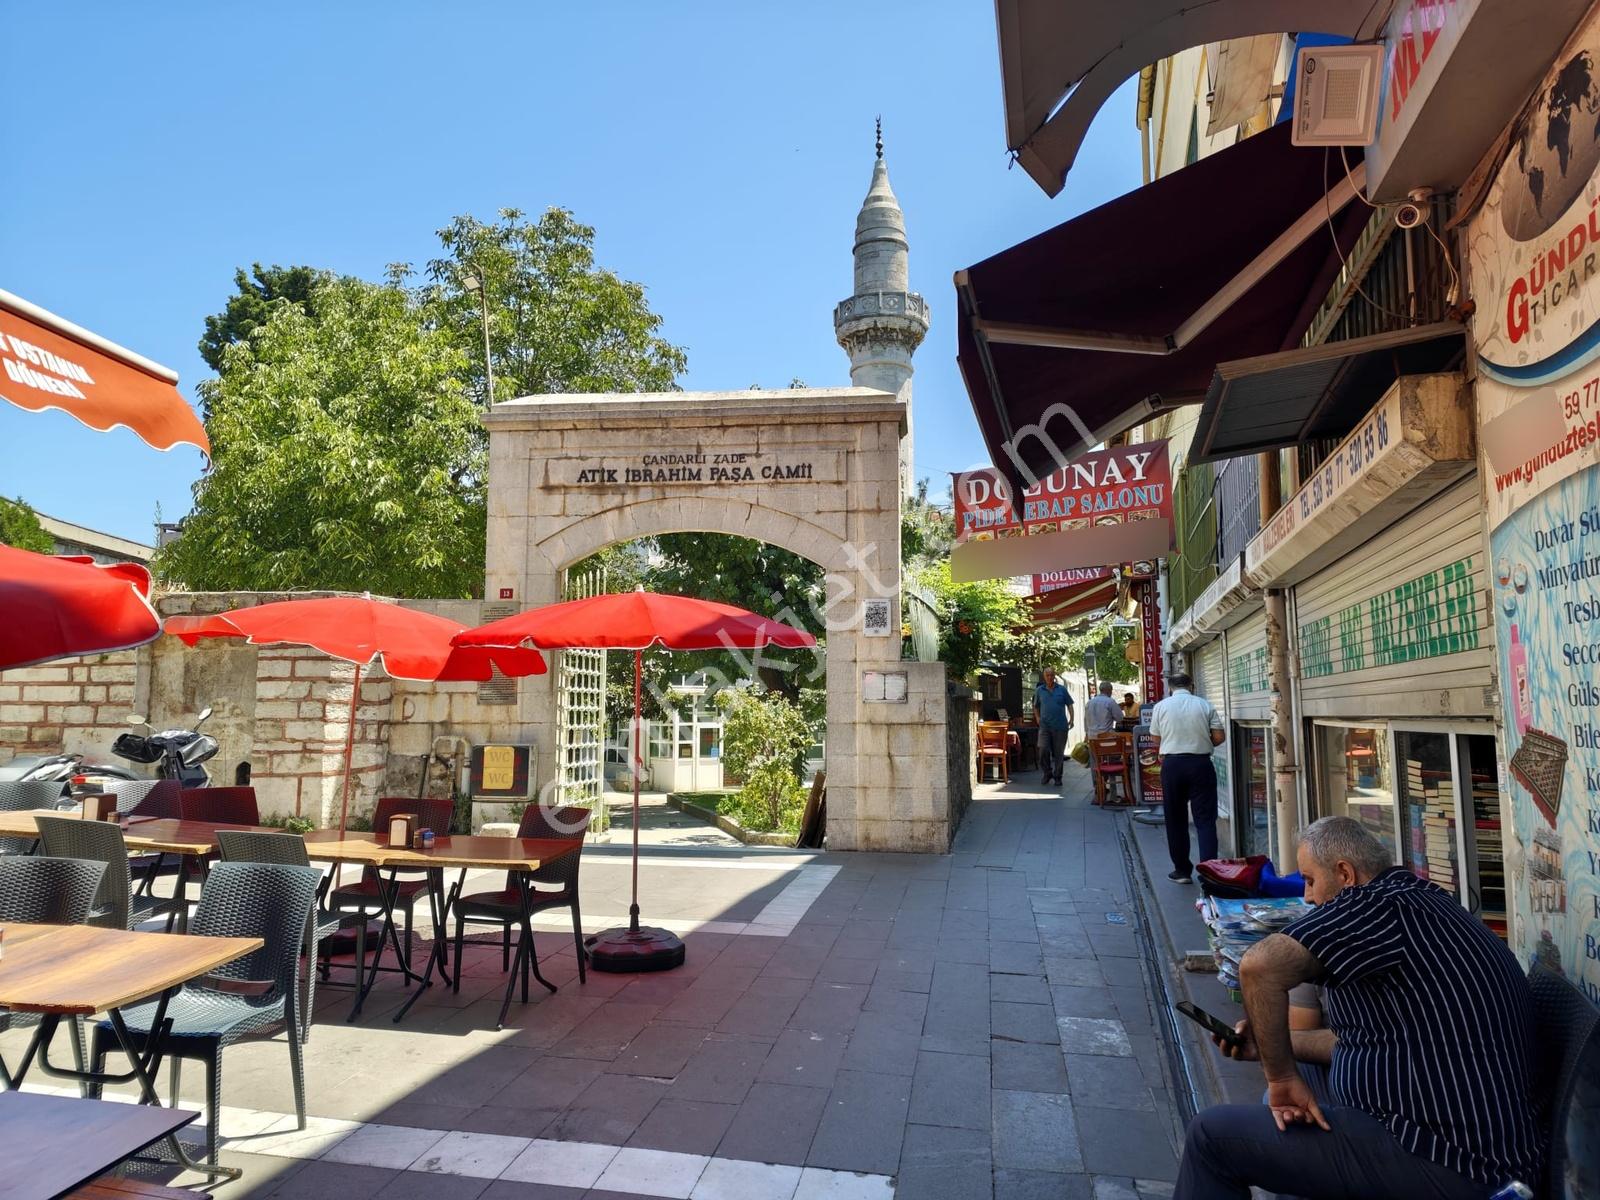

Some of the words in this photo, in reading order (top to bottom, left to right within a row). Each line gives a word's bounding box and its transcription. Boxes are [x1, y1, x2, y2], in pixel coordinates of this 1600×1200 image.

[1565, 391, 1580, 419] 59
[1583, 378, 1600, 408] 77
[1365, 423, 1375, 463] 55
[1377, 408, 1388, 451] 86
[713, 454, 748, 465] ZADE
[577, 467, 618, 483] ATİK
[625, 465, 702, 483] İBRAHİM
[709, 466, 755, 483] PAŞA
[761, 463, 813, 480] CAMİİ
[1080, 483, 1164, 514] SALONU
[1535, 521, 1575, 553] Duvar
[1041, 567, 1101, 583] DOLUNAY
[1143, 583, 1153, 664] DOLUNAY
[489, 751, 510, 762] WC
[489, 772, 509, 784] WC
